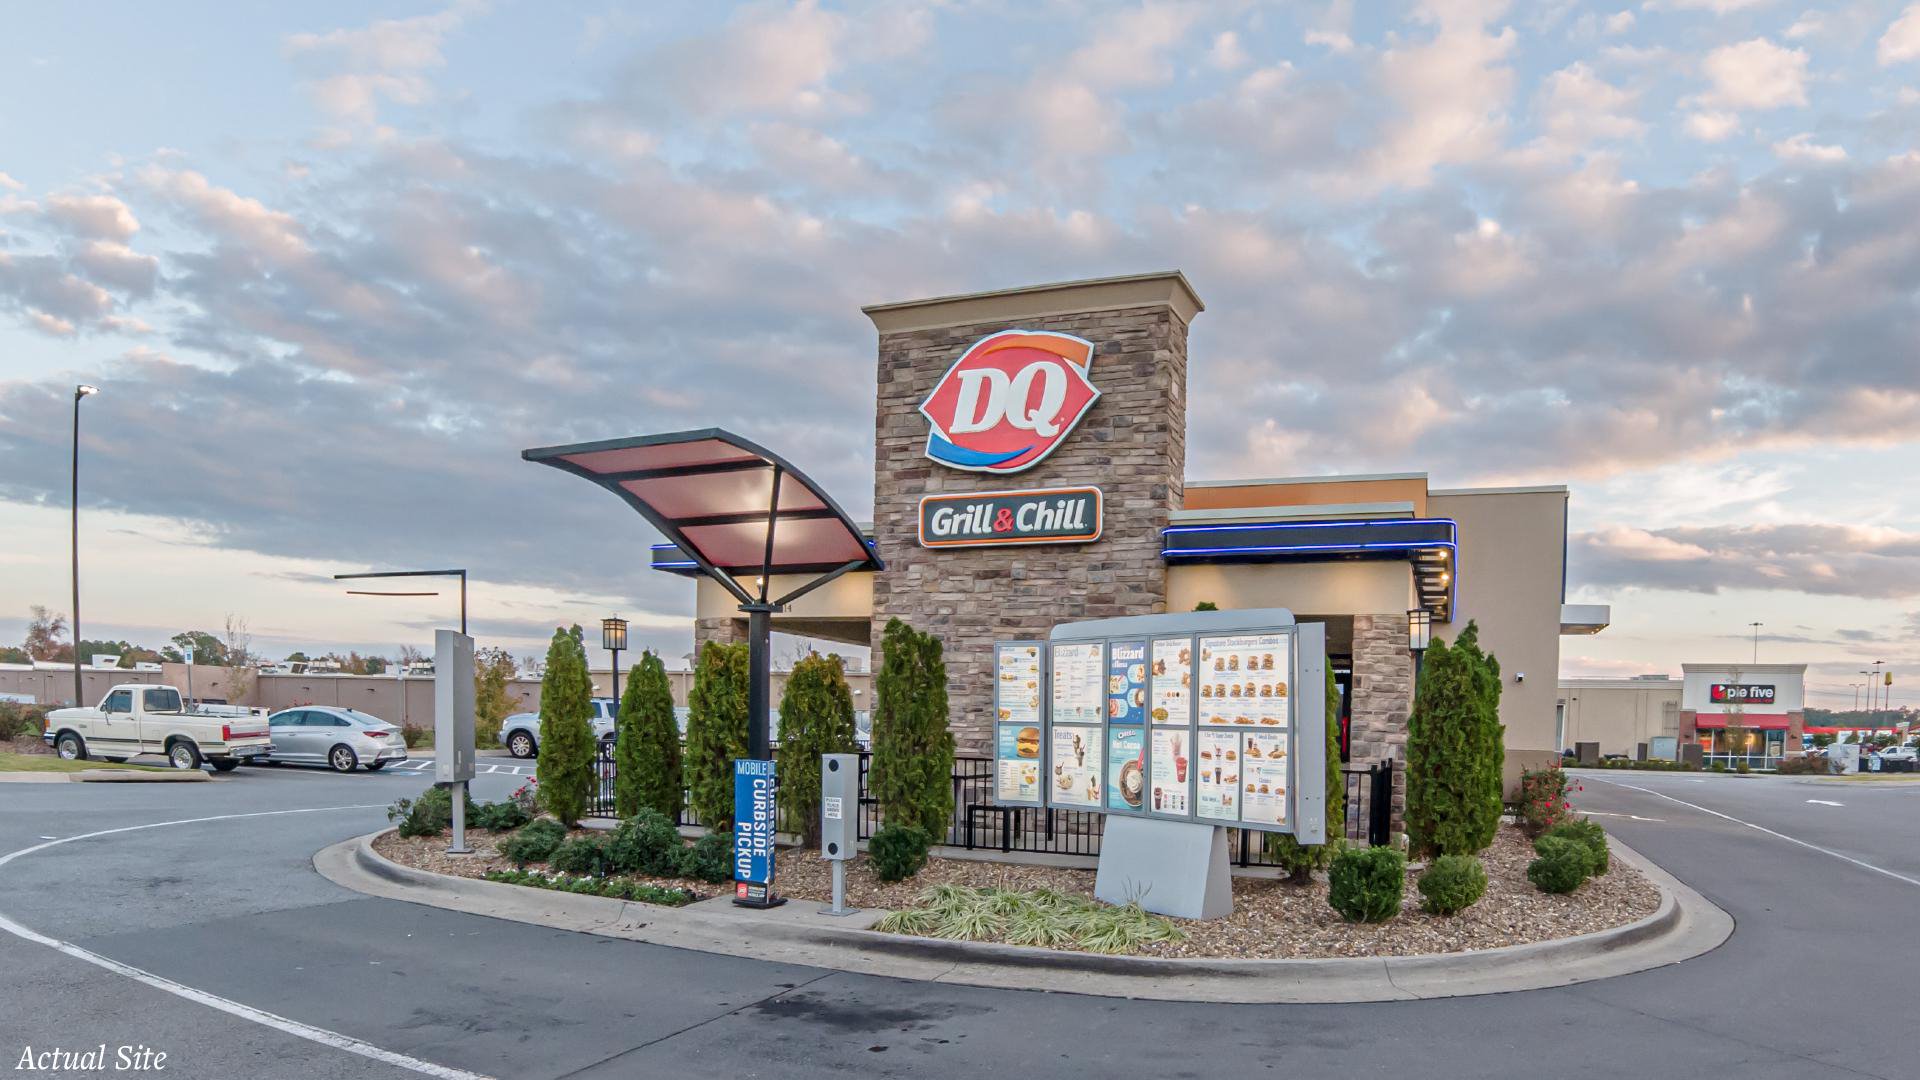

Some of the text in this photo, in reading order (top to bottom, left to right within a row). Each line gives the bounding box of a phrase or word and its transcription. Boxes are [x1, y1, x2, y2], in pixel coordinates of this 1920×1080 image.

[949, 361, 1068, 437] DQ
[931, 498, 1086, 535] Grill & Chill
[1111, 646, 1144, 660] Blizzard
[1727, 686, 1774, 699] pie five
[1054, 729, 1073, 740] Treats
[737, 761, 767, 776] MOBILE
[753, 779, 766, 857] CURBSIDE
[738, 822, 751, 879] PICKUP
